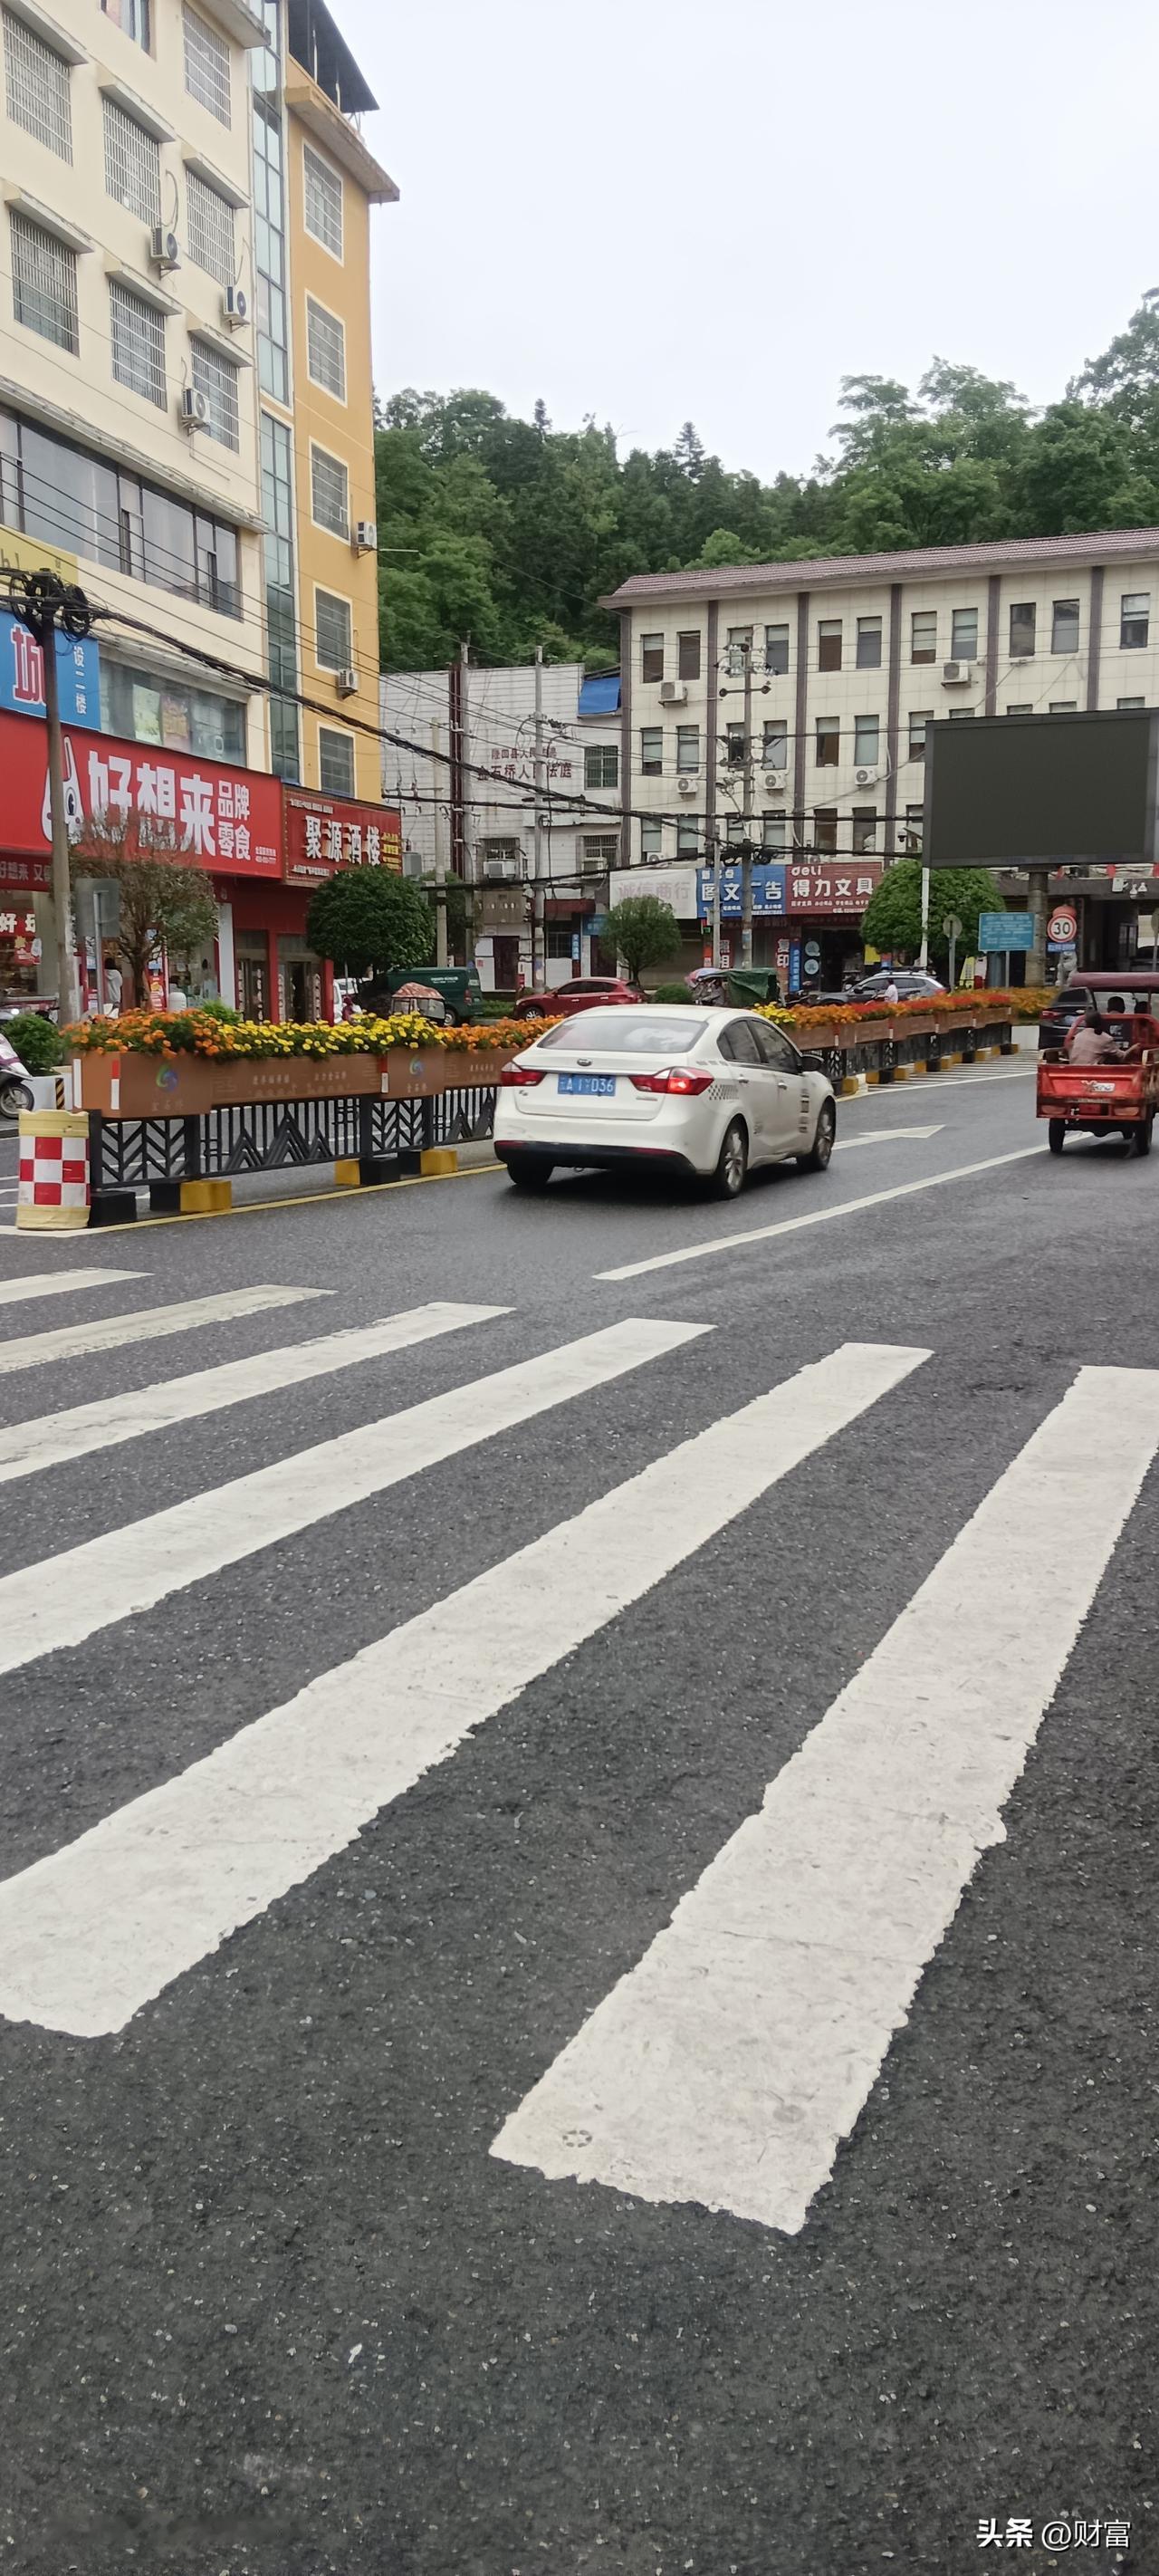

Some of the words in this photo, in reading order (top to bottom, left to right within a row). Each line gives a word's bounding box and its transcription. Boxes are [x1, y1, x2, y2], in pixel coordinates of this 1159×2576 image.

[217, 780, 251, 821] 品牌
[218, 821, 251, 860] 零食
[305, 815, 381, 866] 聚源酒楼
[790, 866, 821, 876] deli
[792, 878, 874, 898] 得力文具
[1053, 922, 1071, 936] 30
